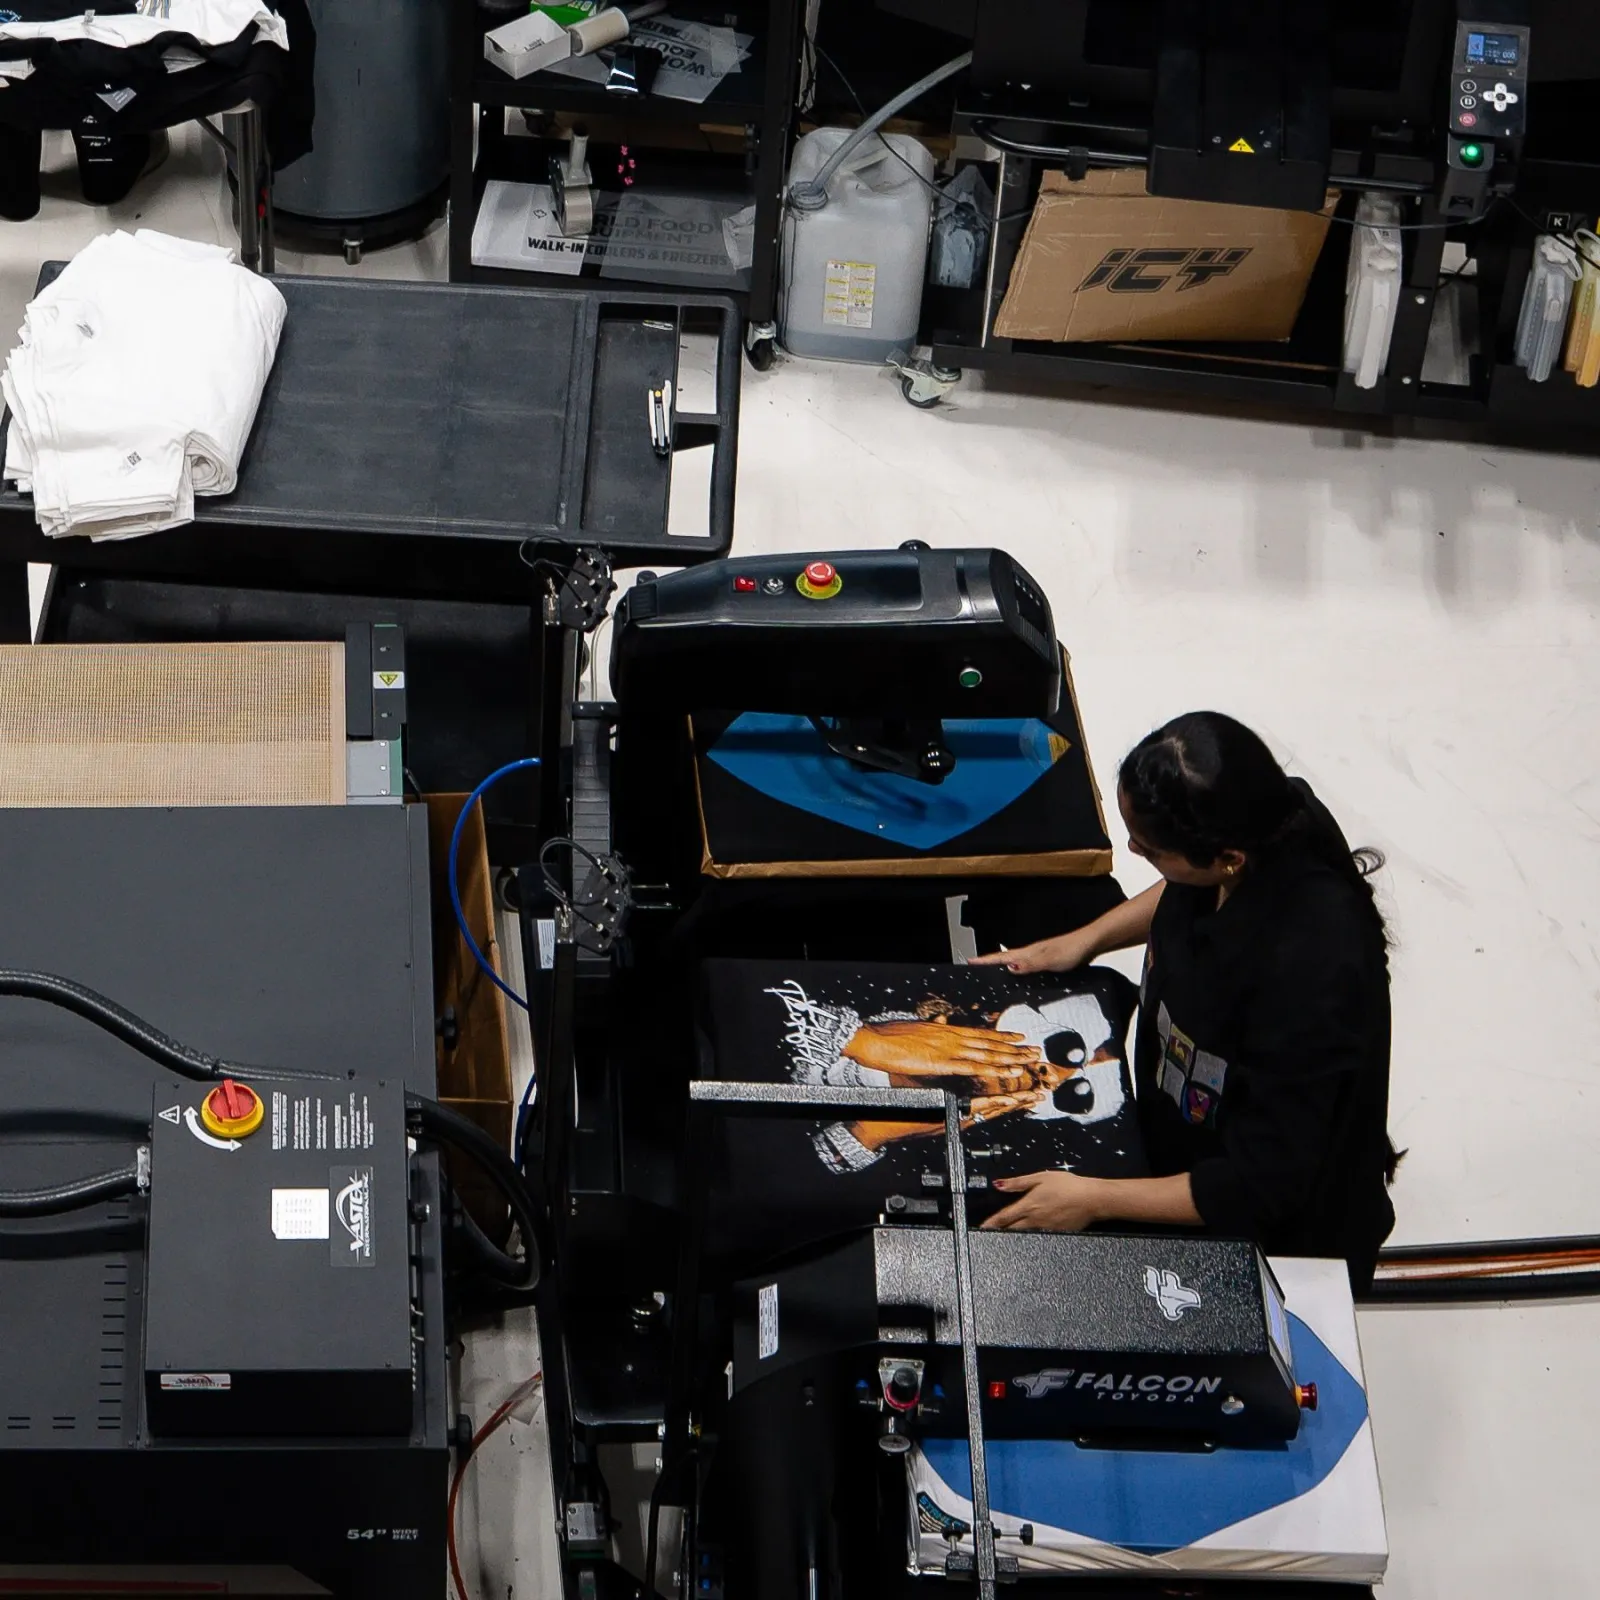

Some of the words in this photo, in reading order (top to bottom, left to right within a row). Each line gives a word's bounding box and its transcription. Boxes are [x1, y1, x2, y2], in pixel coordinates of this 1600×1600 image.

[648, 218, 714, 234] FOOD
[1553, 217, 1563, 227] K
[528, 236, 585, 254] WALK-IN
[349, 1176, 364, 1252] VASTEX
[1075, 1372, 1222, 1393] FALCON
[1097, 1392, 1194, 1403] TOYODA
